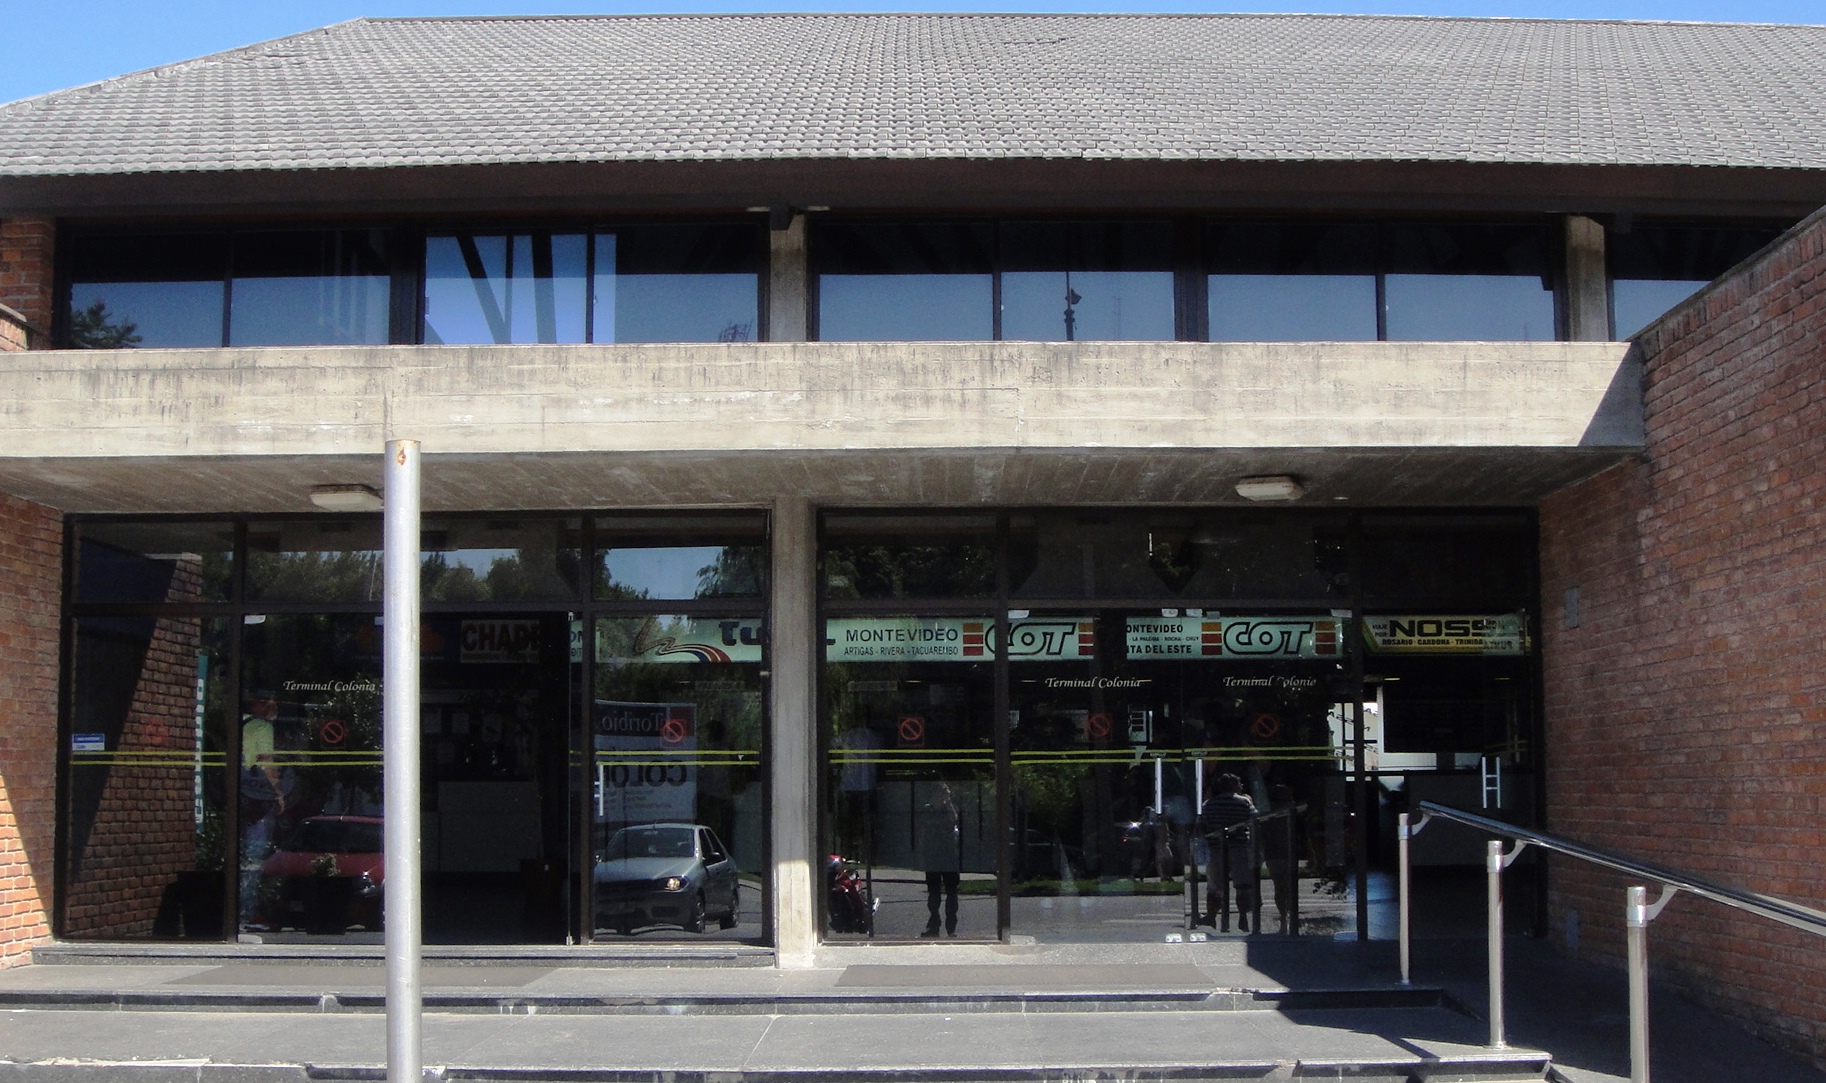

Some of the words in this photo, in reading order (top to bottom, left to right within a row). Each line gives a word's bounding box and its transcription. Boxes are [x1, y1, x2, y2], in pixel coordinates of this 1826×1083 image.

[846, 629, 958, 642] MONTEVIDEO
[985, 622, 1077, 655] COT
[1224, 621, 1314, 655] COT
[844, 646, 874, 656] ARTIGAS
[880, 646, 905, 656] RIVERA
[1145, 645, 1164, 653] DEL
[1167, 645, 1192, 653] ESTE
[282, 679, 334, 691] Terminal
[334, 679, 376, 692] Colonia
[1045, 676, 1097, 688] Terminal
[1098, 676, 1140, 689] Colonia
[1222, 675, 1274, 687] Terminal
